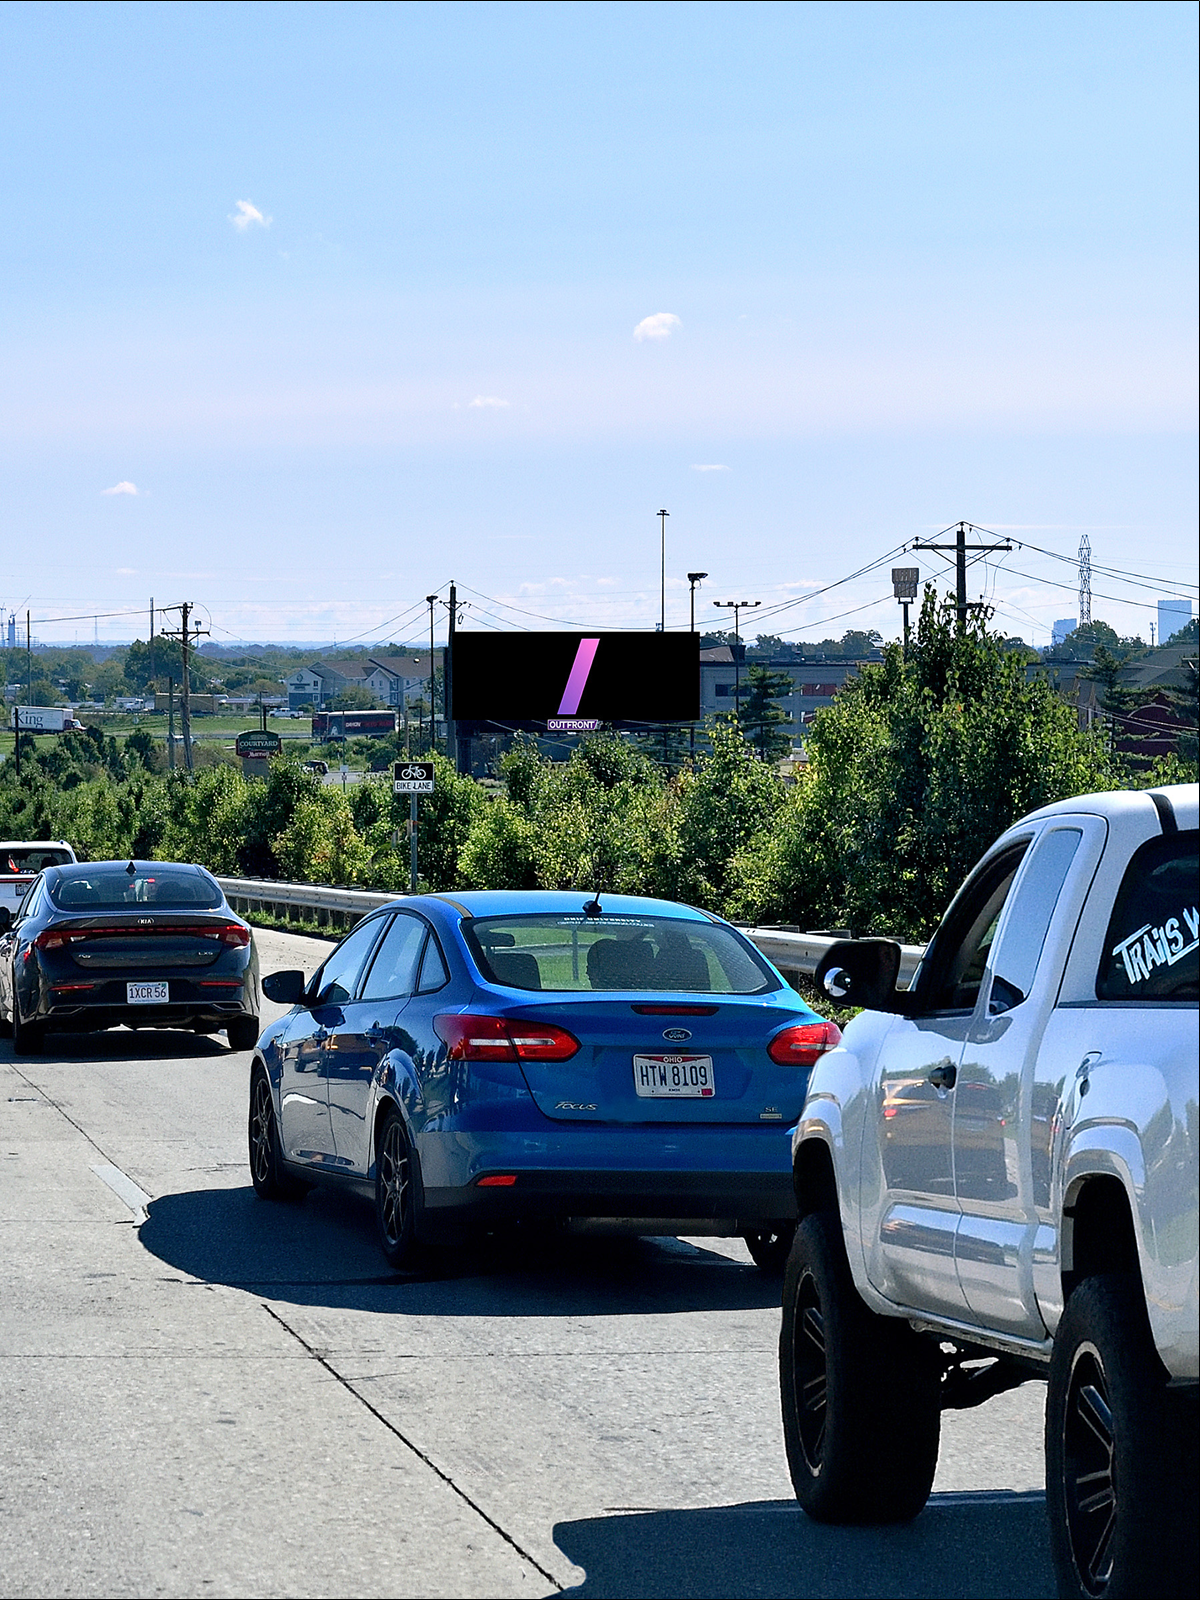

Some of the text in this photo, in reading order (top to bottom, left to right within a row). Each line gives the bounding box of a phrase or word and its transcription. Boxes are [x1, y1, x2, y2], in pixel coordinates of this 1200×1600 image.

[13, 711, 43, 728] King
[550, 721, 595, 729] OUTFRONT
[397, 782, 431, 790] BIKE LANE
[129, 987, 167, 998] 1XCR 56
[662, 1056, 683, 1064] OHIO
[640, 1065, 708, 1087] HTW 8109
